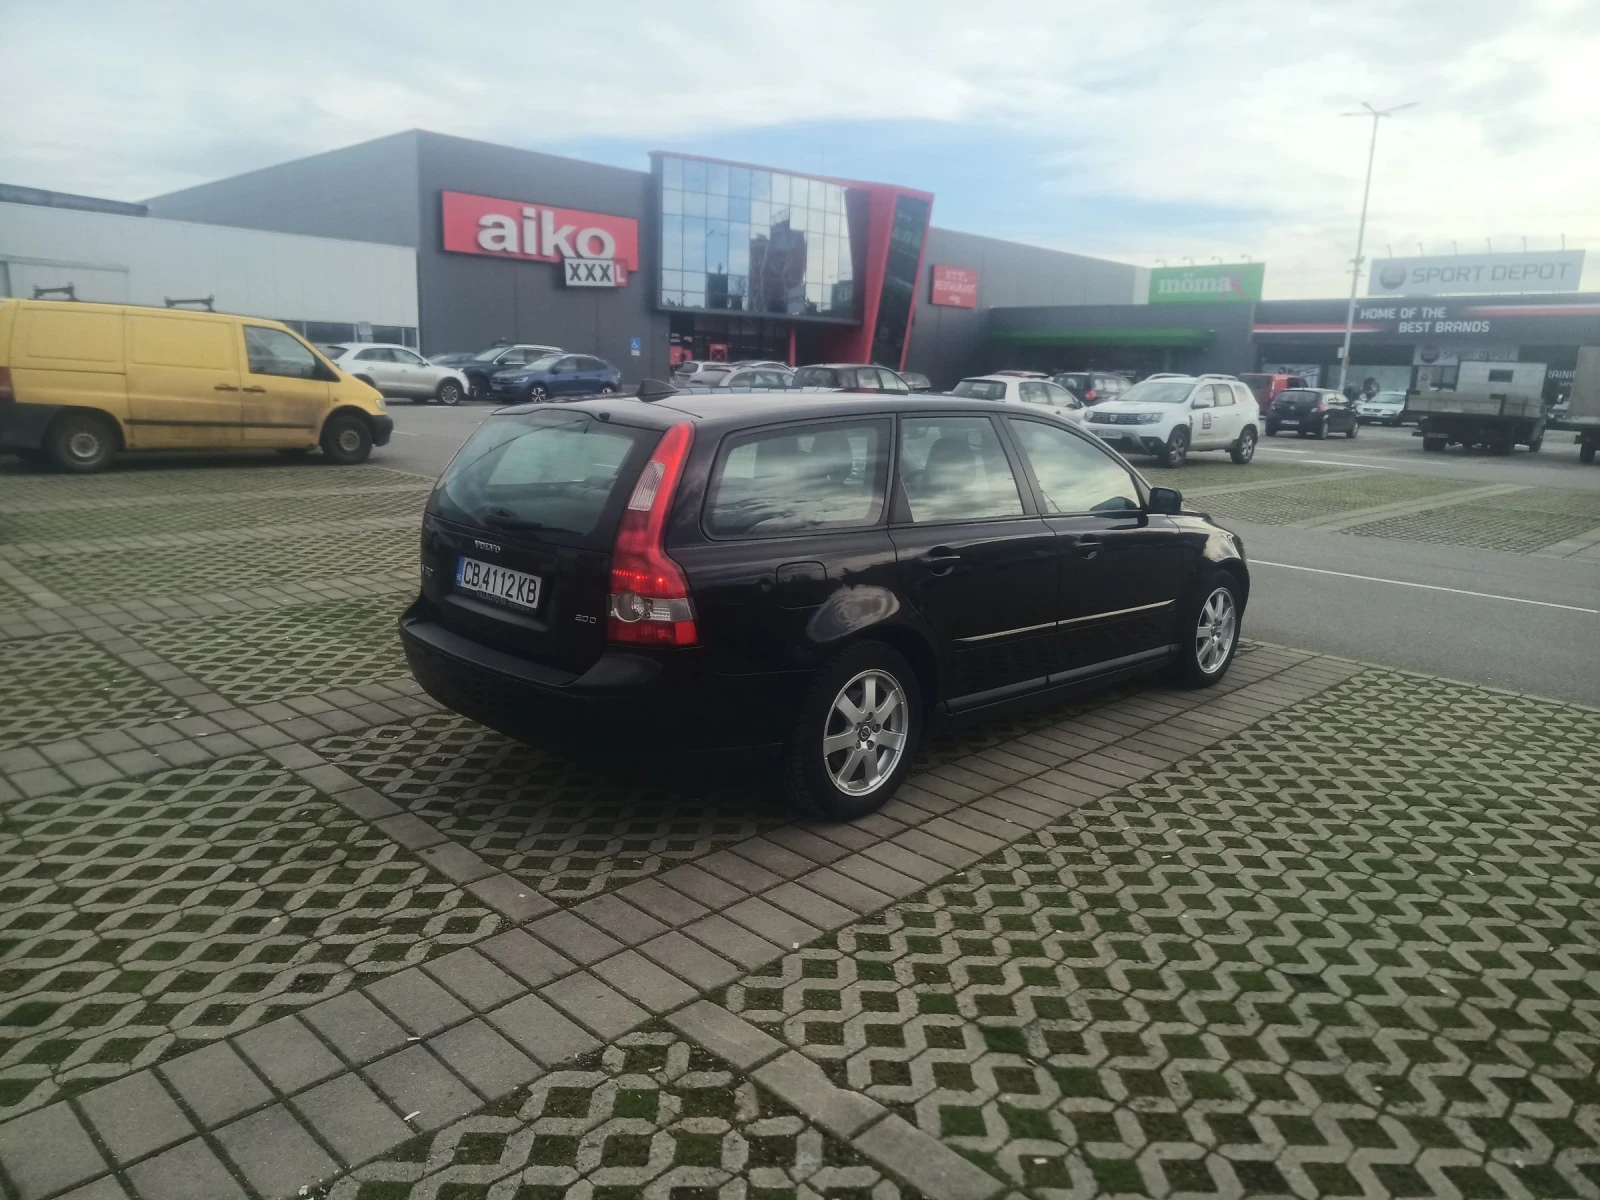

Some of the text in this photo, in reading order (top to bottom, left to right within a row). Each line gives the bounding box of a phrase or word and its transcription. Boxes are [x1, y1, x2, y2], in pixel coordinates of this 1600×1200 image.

[477, 206, 616, 259] aiko
[1411, 262, 1571, 283] SPORT DEPOT
[1360, 306, 1447, 319] HOME OF THE
[1398, 321, 1490, 333] BEST BRANDS
[474, 539, 501, 553] VOLVO
